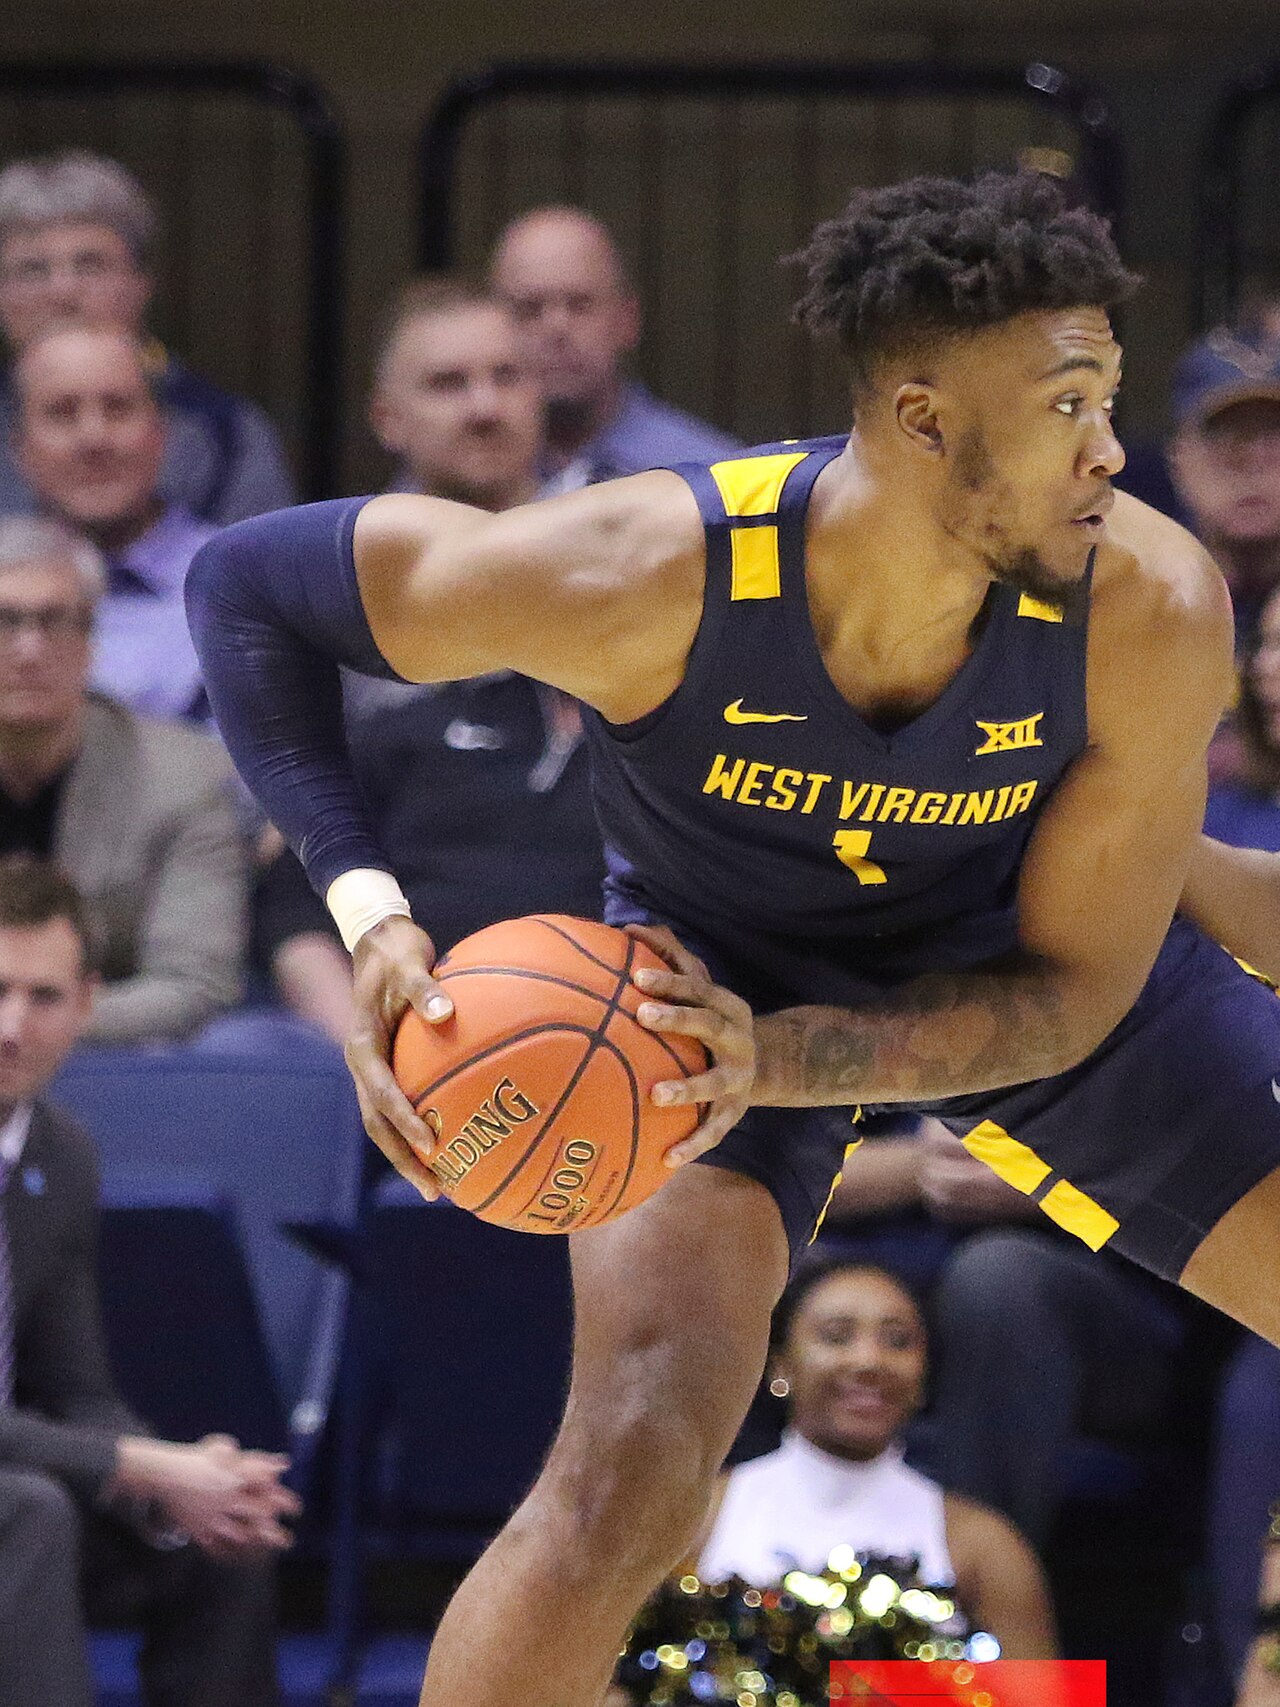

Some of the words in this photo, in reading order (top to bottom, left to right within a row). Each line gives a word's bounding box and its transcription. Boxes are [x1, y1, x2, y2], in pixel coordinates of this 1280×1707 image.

[974, 711, 1044, 756] XII
[702, 753, 832, 815] WEST
[837, 779, 1039, 826] VIRGINIA
[831, 829, 888, 885] 1
[431, 1075, 541, 1190] ALDING
